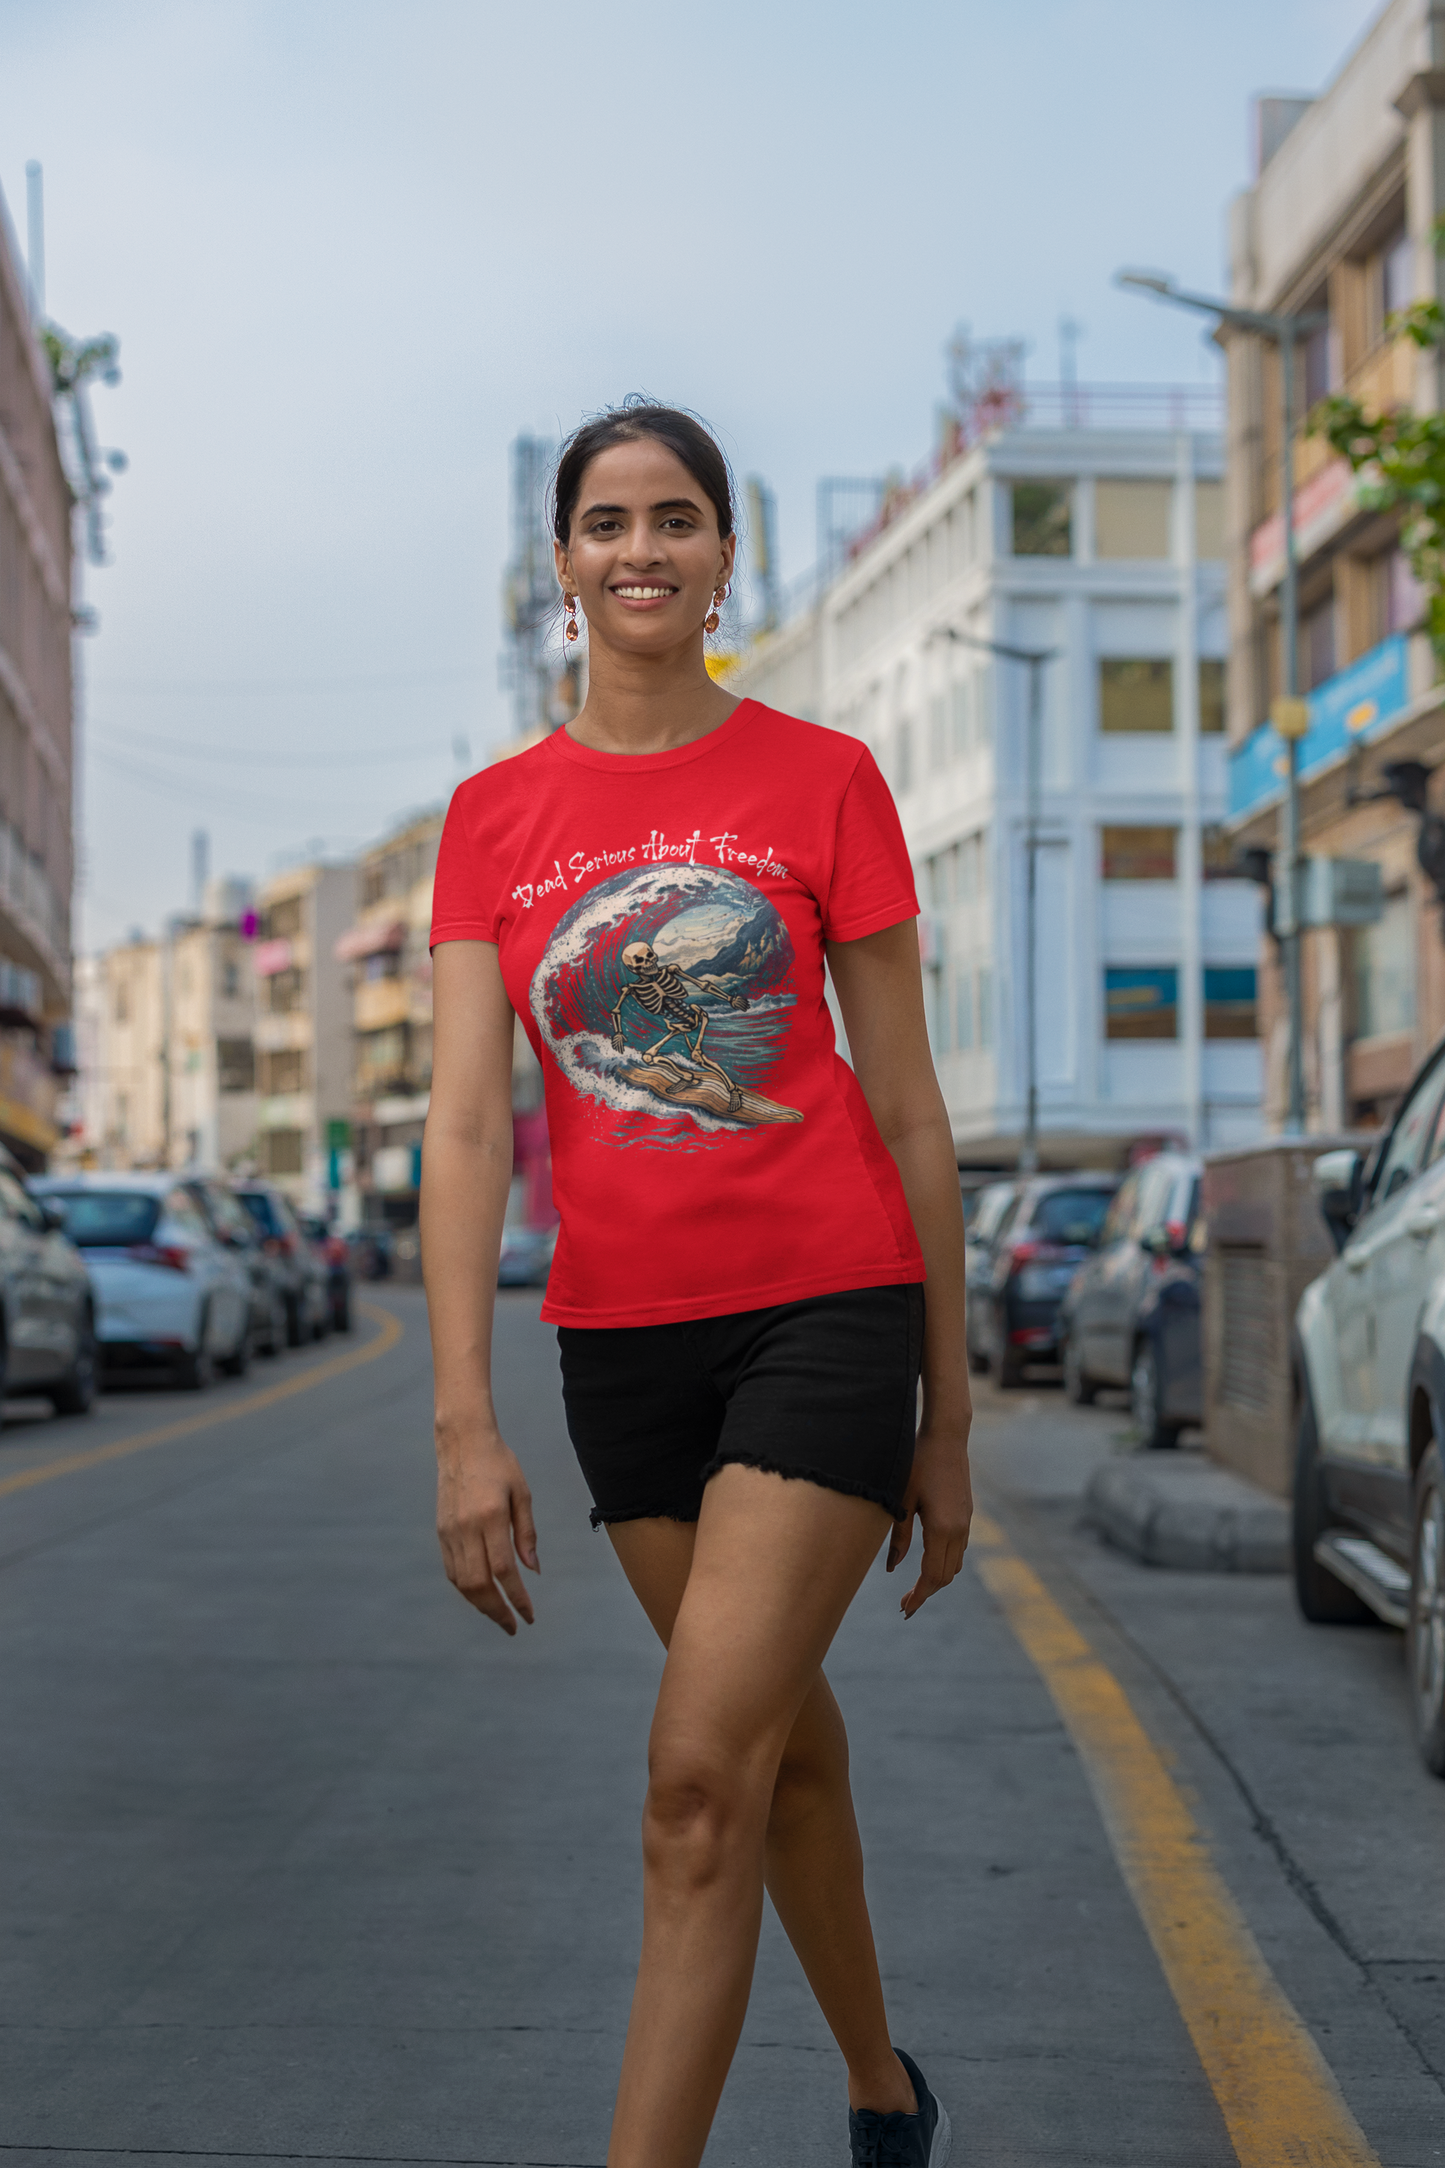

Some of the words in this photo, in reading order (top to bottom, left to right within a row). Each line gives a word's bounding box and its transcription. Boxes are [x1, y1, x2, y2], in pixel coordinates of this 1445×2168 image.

[512, 861, 568, 908] Dead
[568, 847, 636, 883] Serious
[641, 830, 707, 867] About
[710, 832, 789, 880] Freedom
